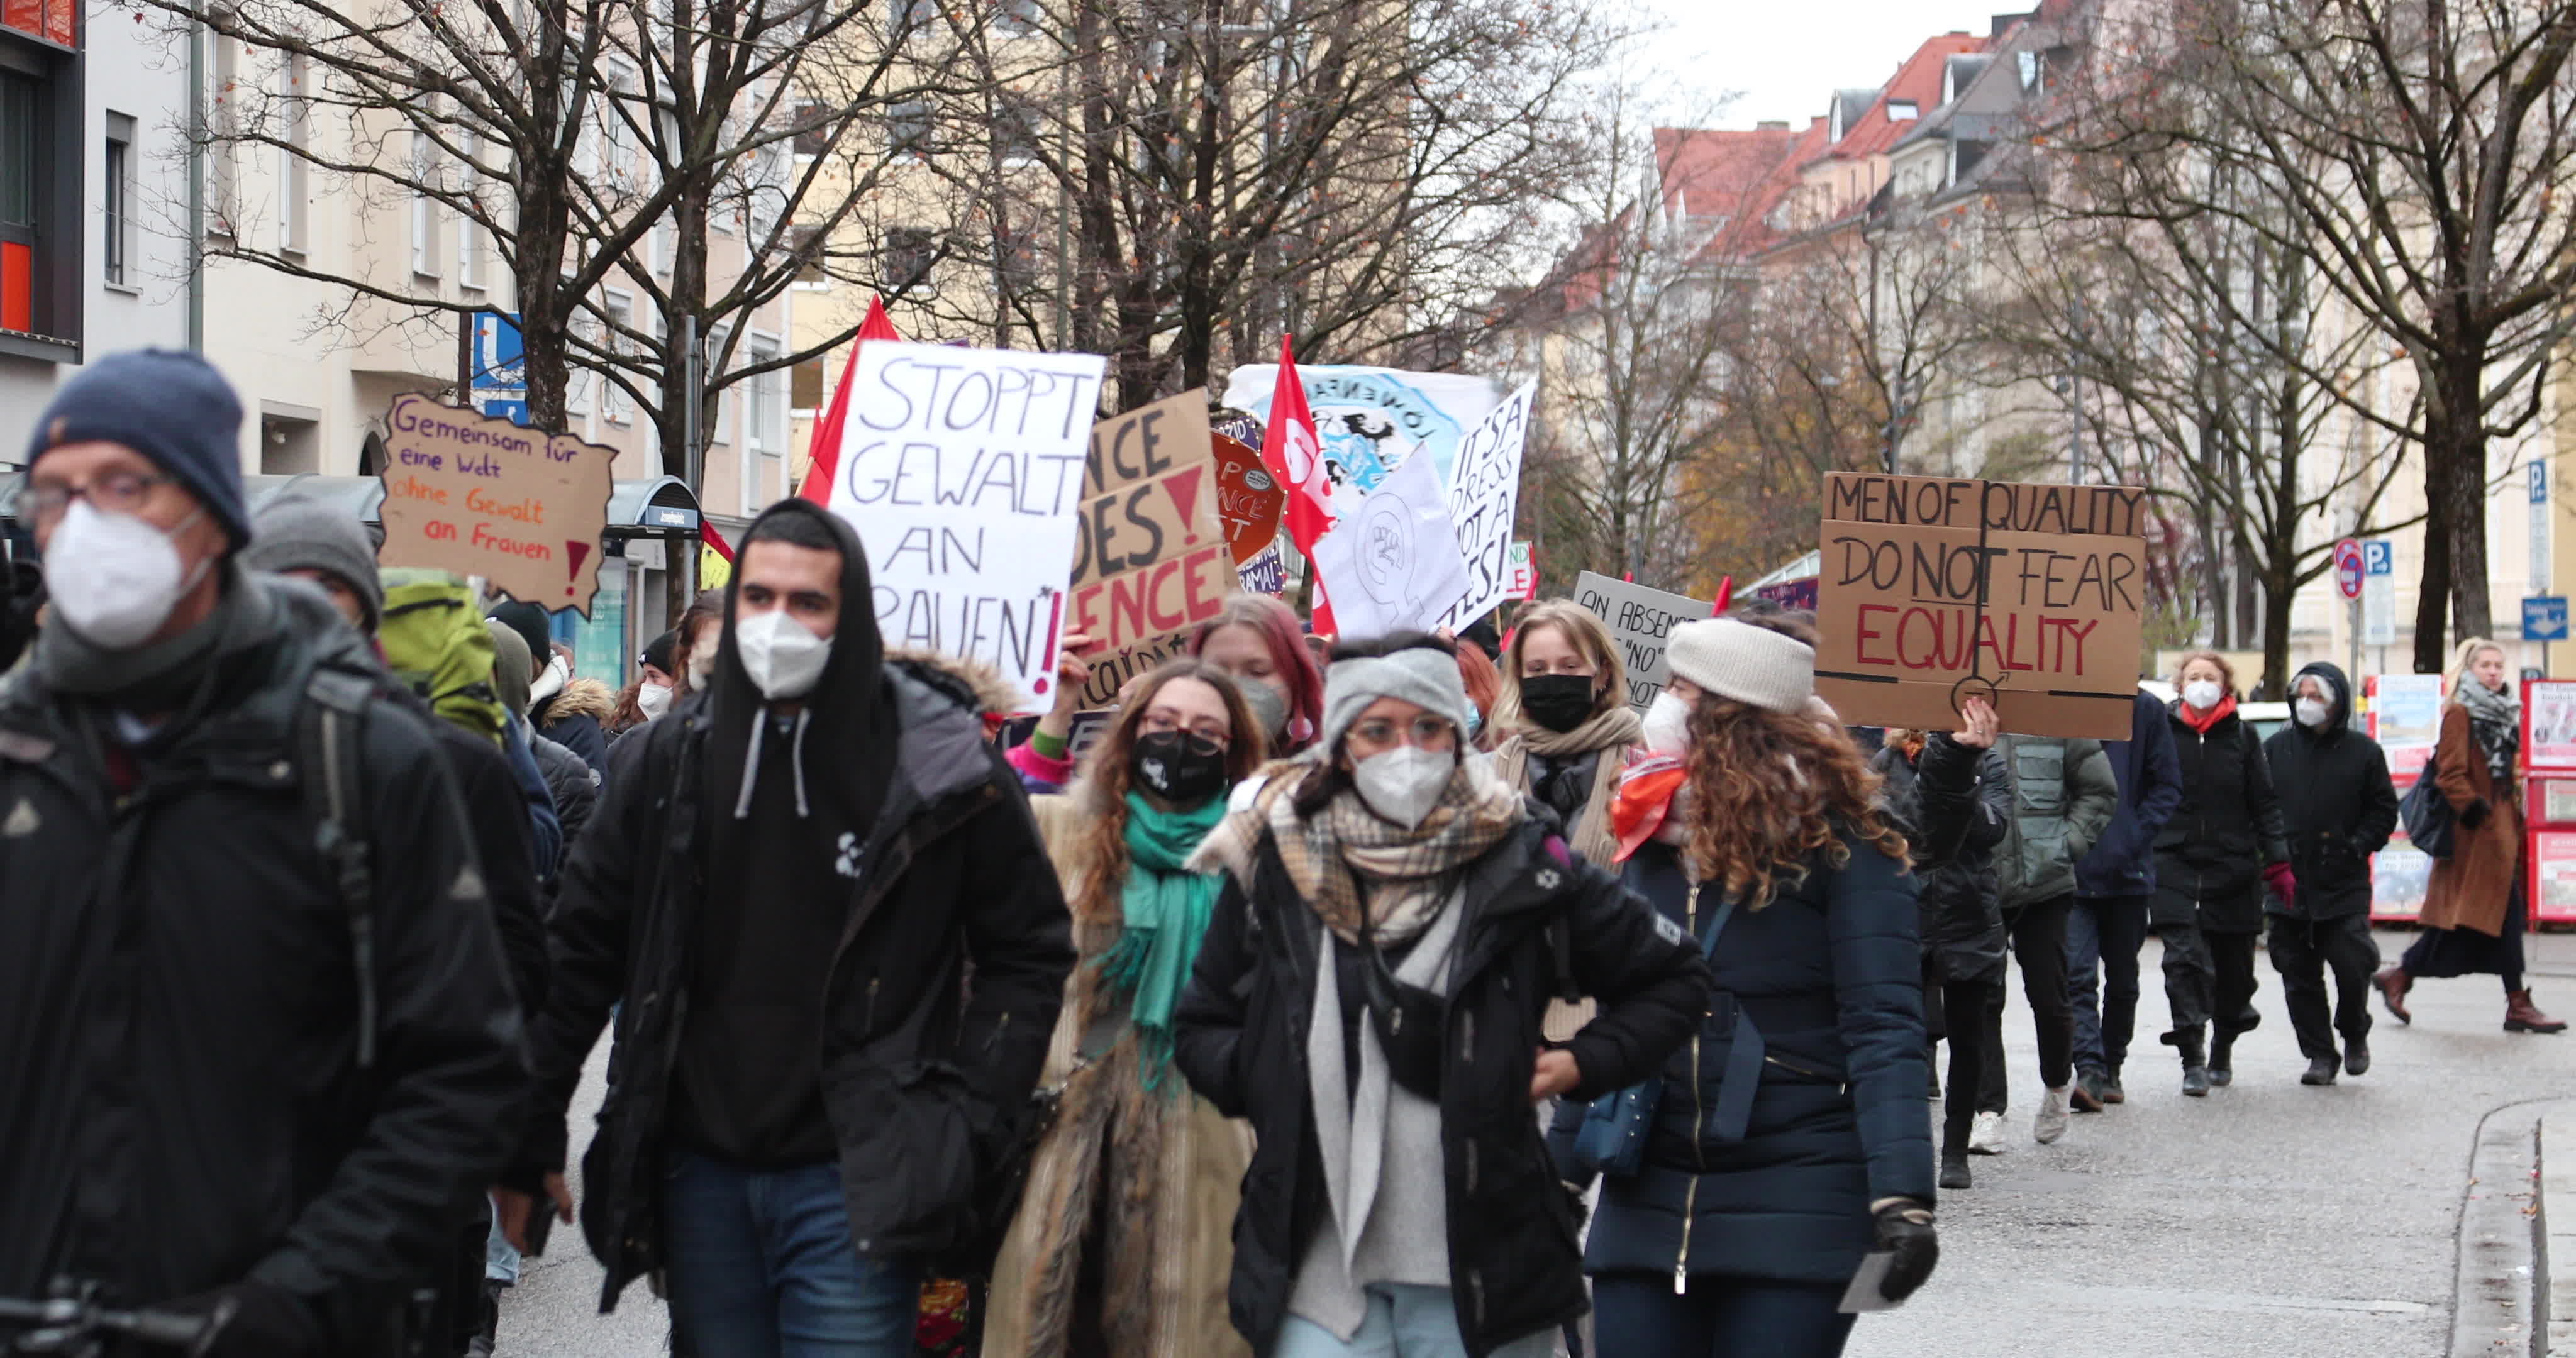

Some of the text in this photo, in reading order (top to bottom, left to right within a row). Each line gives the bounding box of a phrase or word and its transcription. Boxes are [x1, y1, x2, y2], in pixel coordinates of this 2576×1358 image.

[860, 357, 1094, 439] STOPPT
[395, 399, 579, 463] Gemeinsam für
[1087, 410, 1170, 493] NCE
[400, 444, 501, 478] eine Welt
[850, 441, 1085, 516] GEWALT
[1448, 441, 1517, 521] DRESS
[393, 476, 545, 524] ohne Gewalt
[1070, 465, 1202, 586] DES!
[1218, 487, 1264, 518] NCE
[1489, 490, 1509, 538] A
[1831, 477, 2143, 536] MEN OF QUALITY
[425, 519, 457, 541] an
[471, 522, 551, 561] Frauen
[883, 526, 984, 575] AN
[1509, 546, 1528, 565] ND
[1238, 561, 1276, 593] RAMA!
[1833, 536, 2136, 612] DO NOT FEAR
[1077, 548, 1221, 658] ENCE
[1580, 590, 1697, 638] AN ABSEN
[1626, 640, 1665, 672] "NO"
[1857, 604, 2099, 675] EQUALITY
